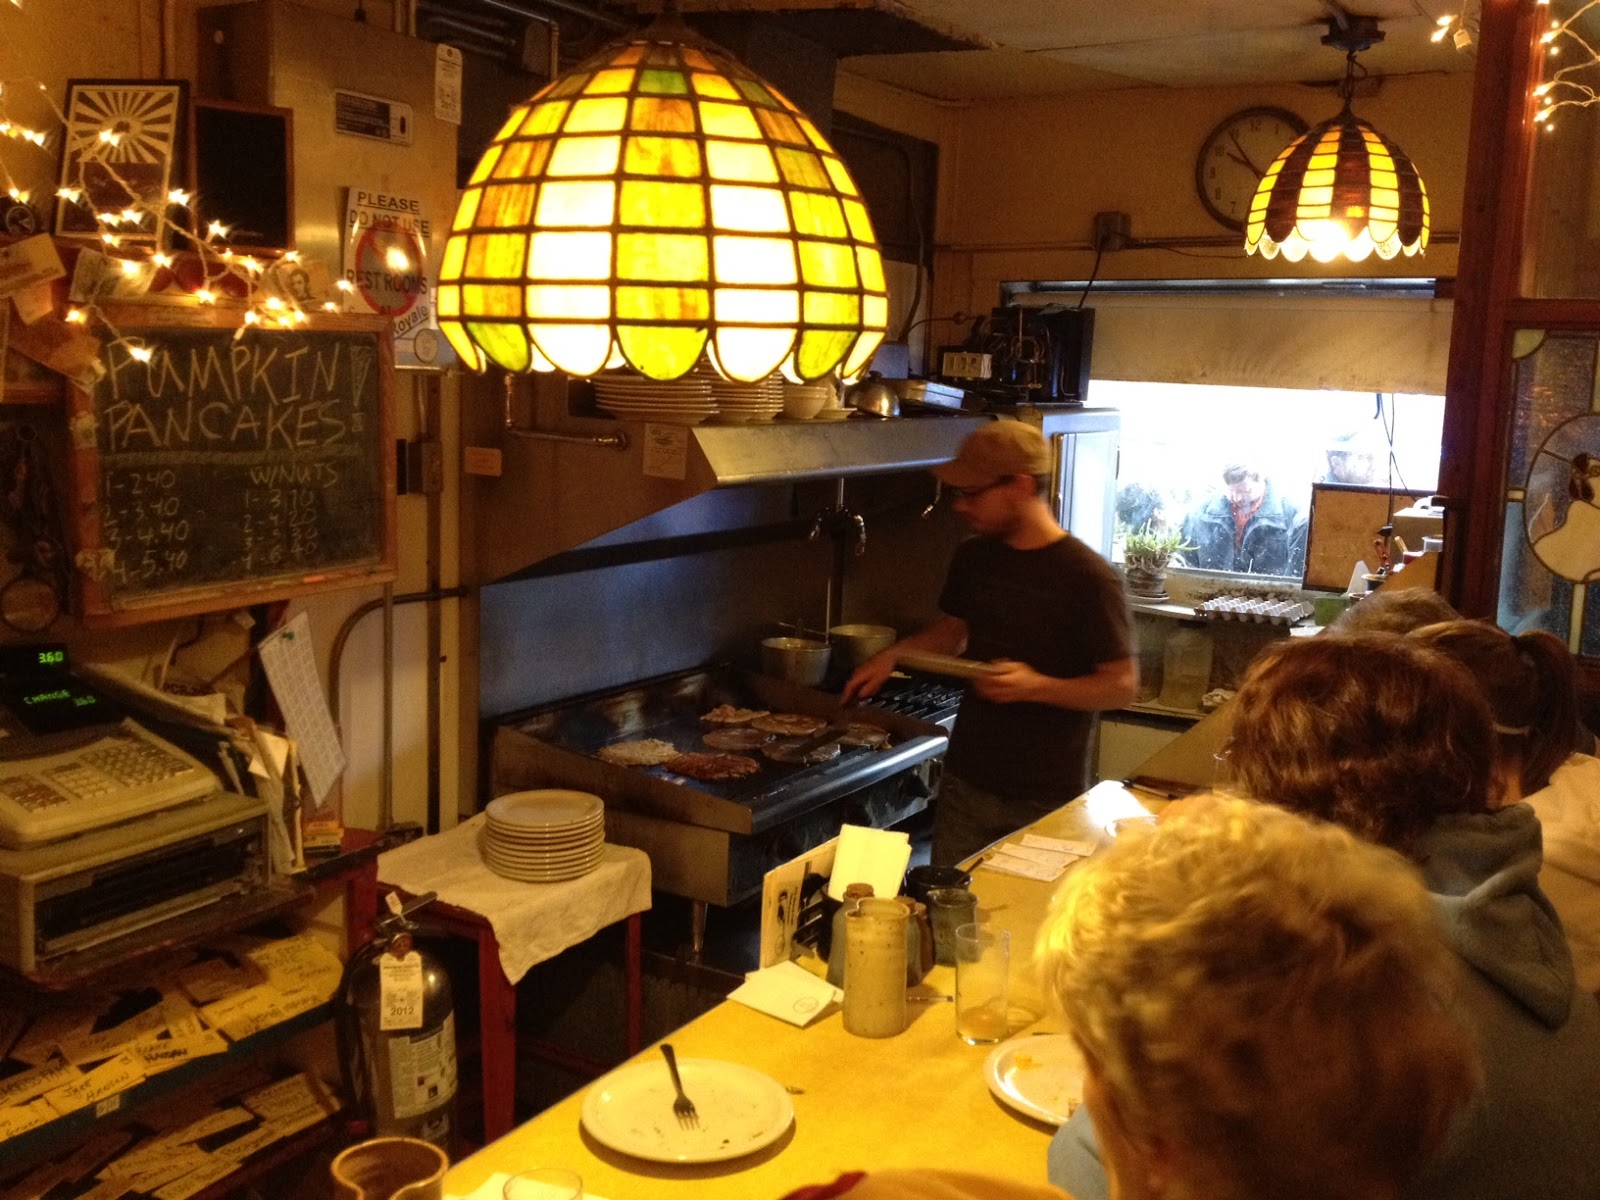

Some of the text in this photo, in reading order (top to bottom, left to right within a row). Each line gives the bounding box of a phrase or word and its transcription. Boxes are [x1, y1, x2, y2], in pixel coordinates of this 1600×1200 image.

[358, 191, 420, 212] PLEASE
[349, 209, 430, 236] DO NOT USE
[346, 269, 428, 295] REST ROOMS
[390, 1006, 415, 1017] 2012
